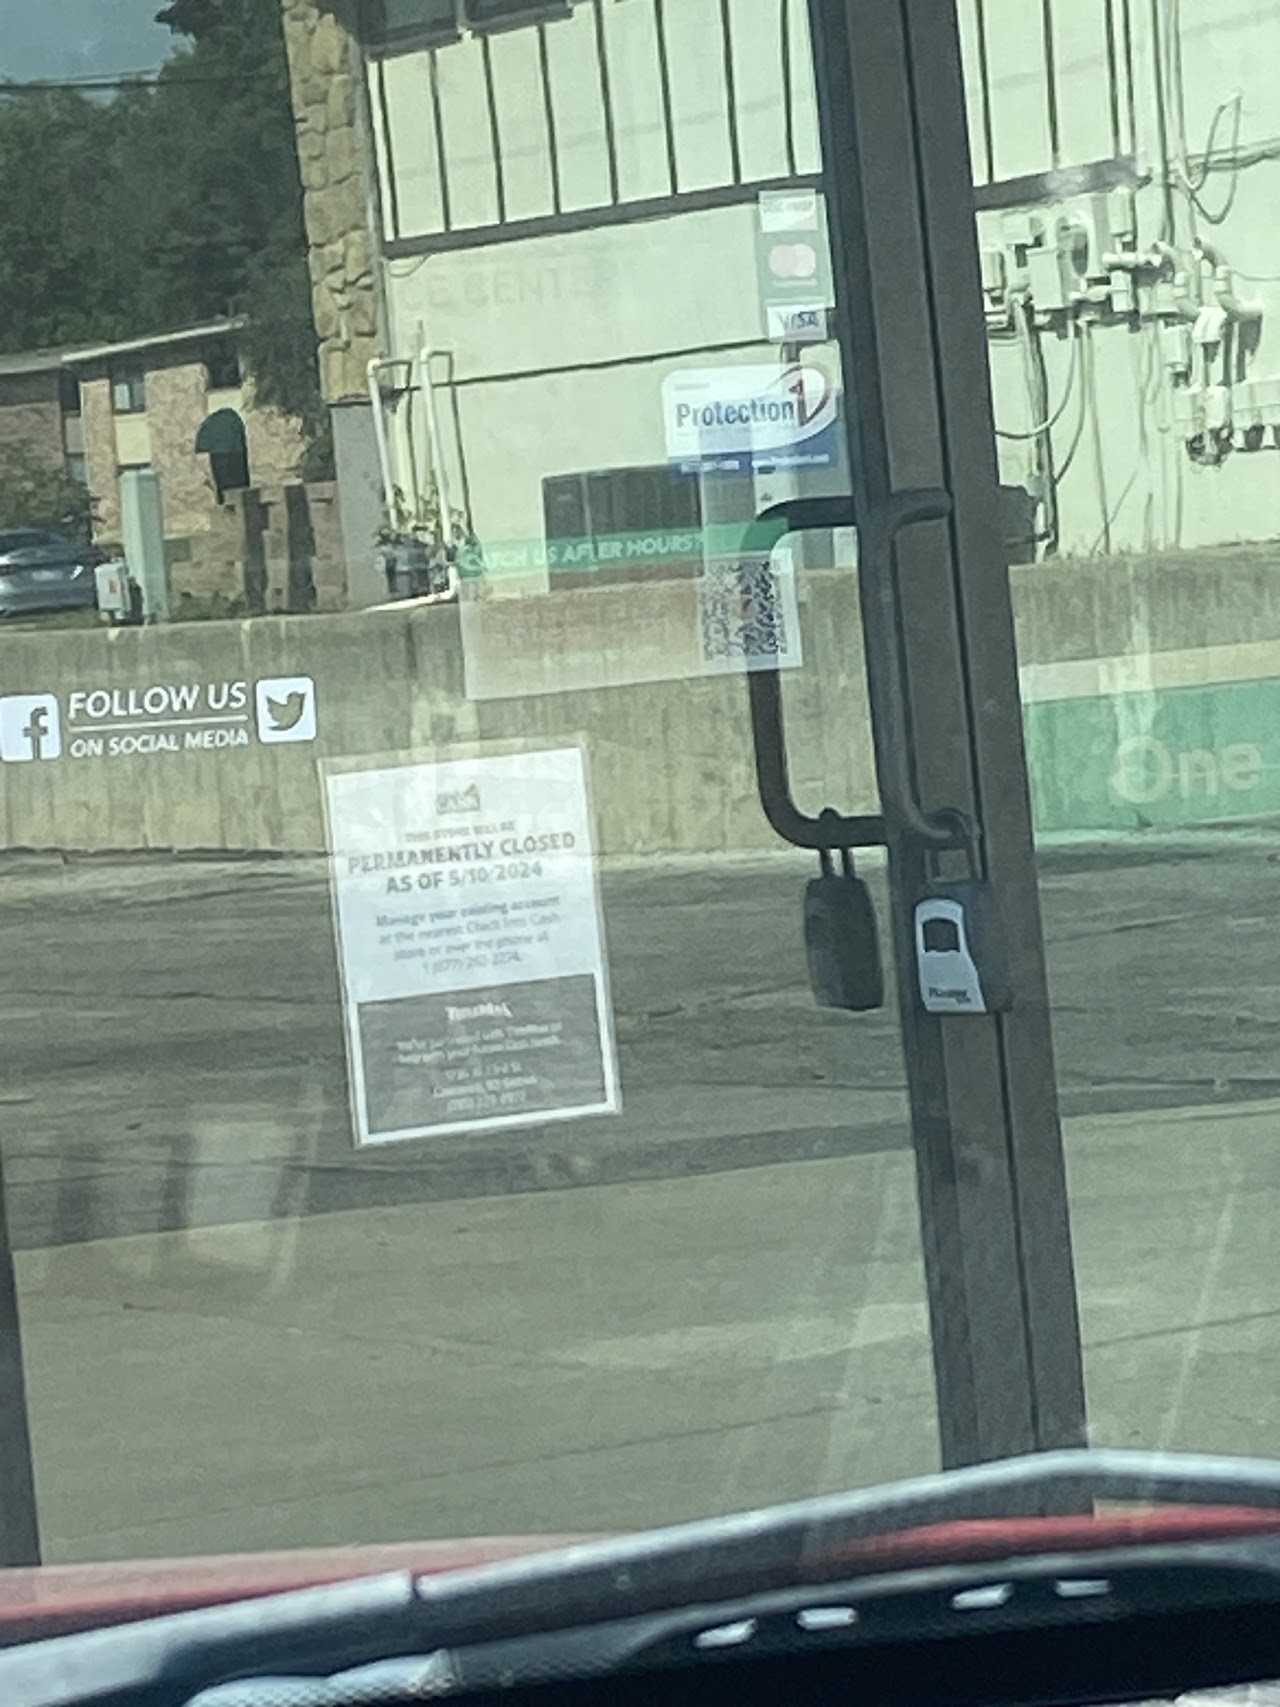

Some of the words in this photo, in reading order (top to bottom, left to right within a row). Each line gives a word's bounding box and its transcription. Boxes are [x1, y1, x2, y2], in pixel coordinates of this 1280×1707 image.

[778, 310, 819, 329] VISA
[676, 399, 795, 427] Protection
[561, 541, 624, 563] AFTER
[68, 684, 200, 719] FOLLOW
[207, 682, 247, 710] US
[70, 737, 103, 758] ON
[109, 732, 179, 755] SOCIAL
[184, 727, 249, 750] MEDIA
[1110, 735, 1263, 804] One
[347, 841, 495, 874] PERMANENTLY
[499, 831, 576, 857] CLOSED
[386, 874, 413, 894] AS
[417, 870, 444, 890] OF
[448, 860, 543, 887] 5/10/2024
